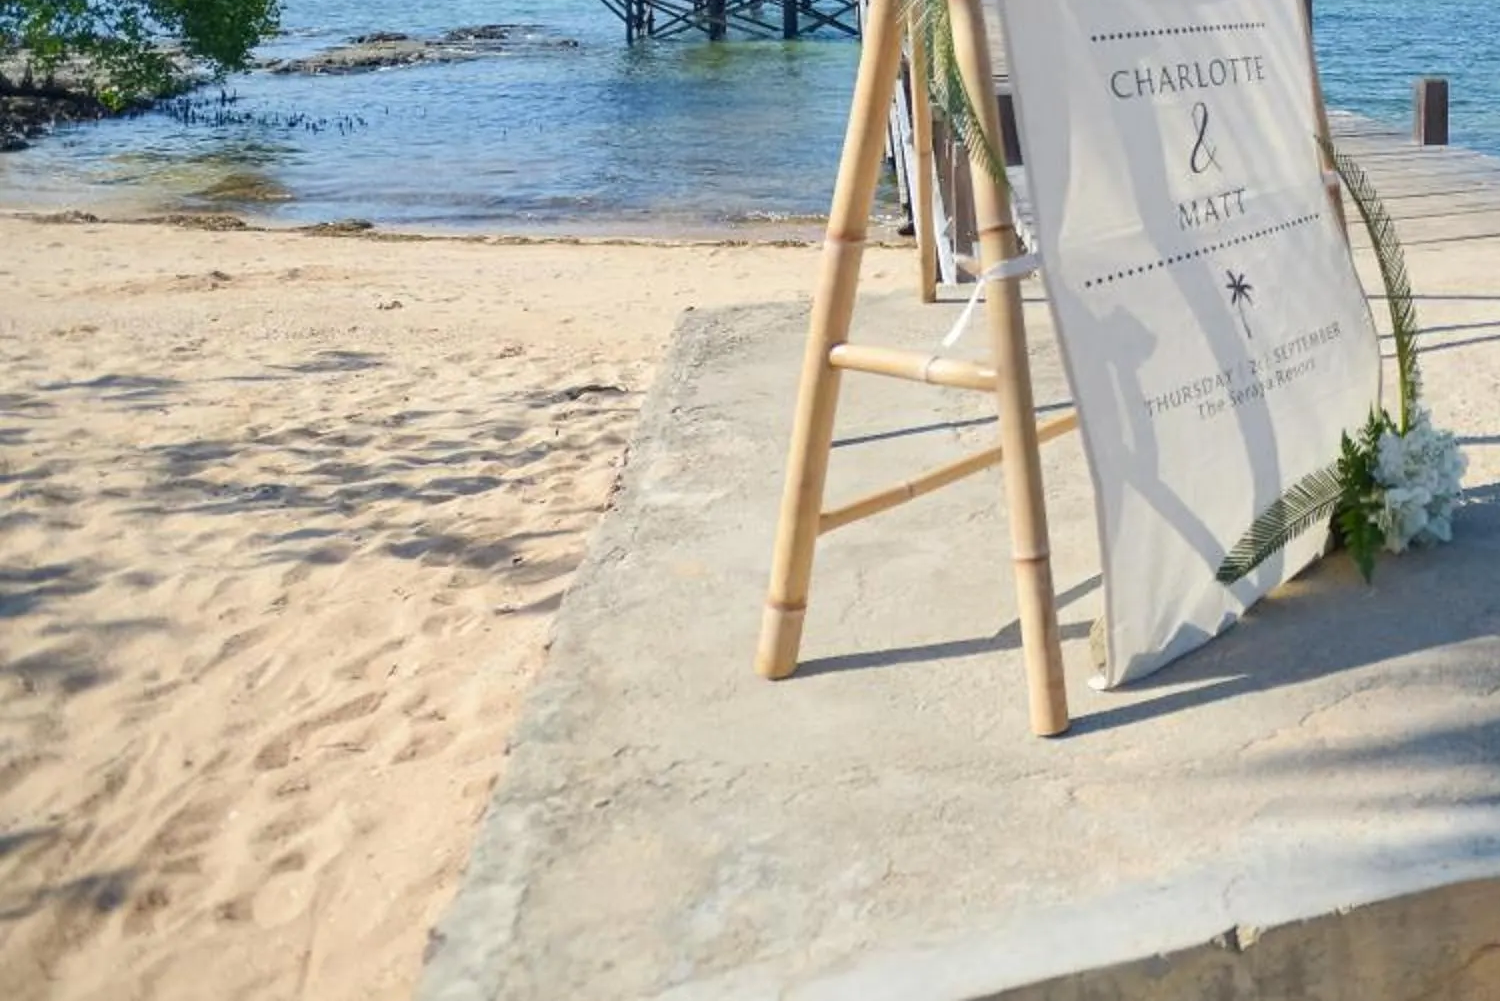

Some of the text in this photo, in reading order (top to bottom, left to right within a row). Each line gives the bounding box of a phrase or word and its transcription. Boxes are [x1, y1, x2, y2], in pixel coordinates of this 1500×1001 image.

[1110, 55, 1266, 99] CHARLOTTE
[1190, 102, 1223, 174] &
[1178, 187, 1247, 231] MATT
[1143, 369, 1235, 418] THURSDAY
